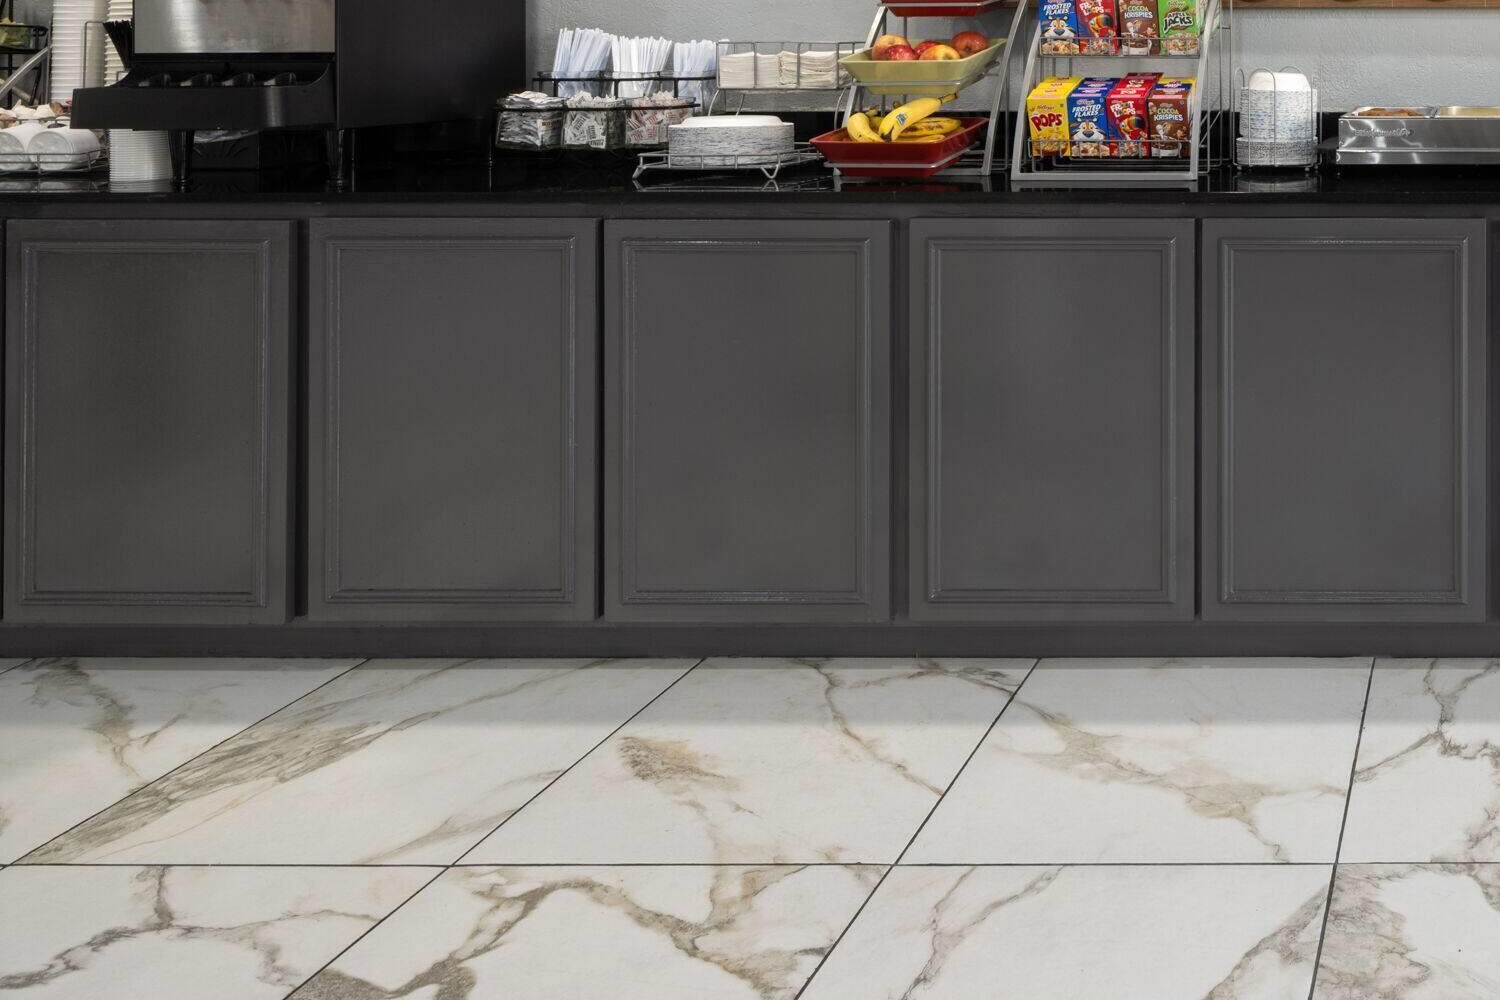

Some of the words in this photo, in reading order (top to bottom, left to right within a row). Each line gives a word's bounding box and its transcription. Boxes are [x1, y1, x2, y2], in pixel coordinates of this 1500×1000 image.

[1043, 2, 1072, 11] FROSTED
[1124, 11, 1153, 19] KRISPIES
[1163, 16, 1193, 34] JACKS
[1072, 104, 1102, 113] FROSTED
[1074, 110, 1099, 118] FLAKES
[1031, 112, 1063, 132] POPS
